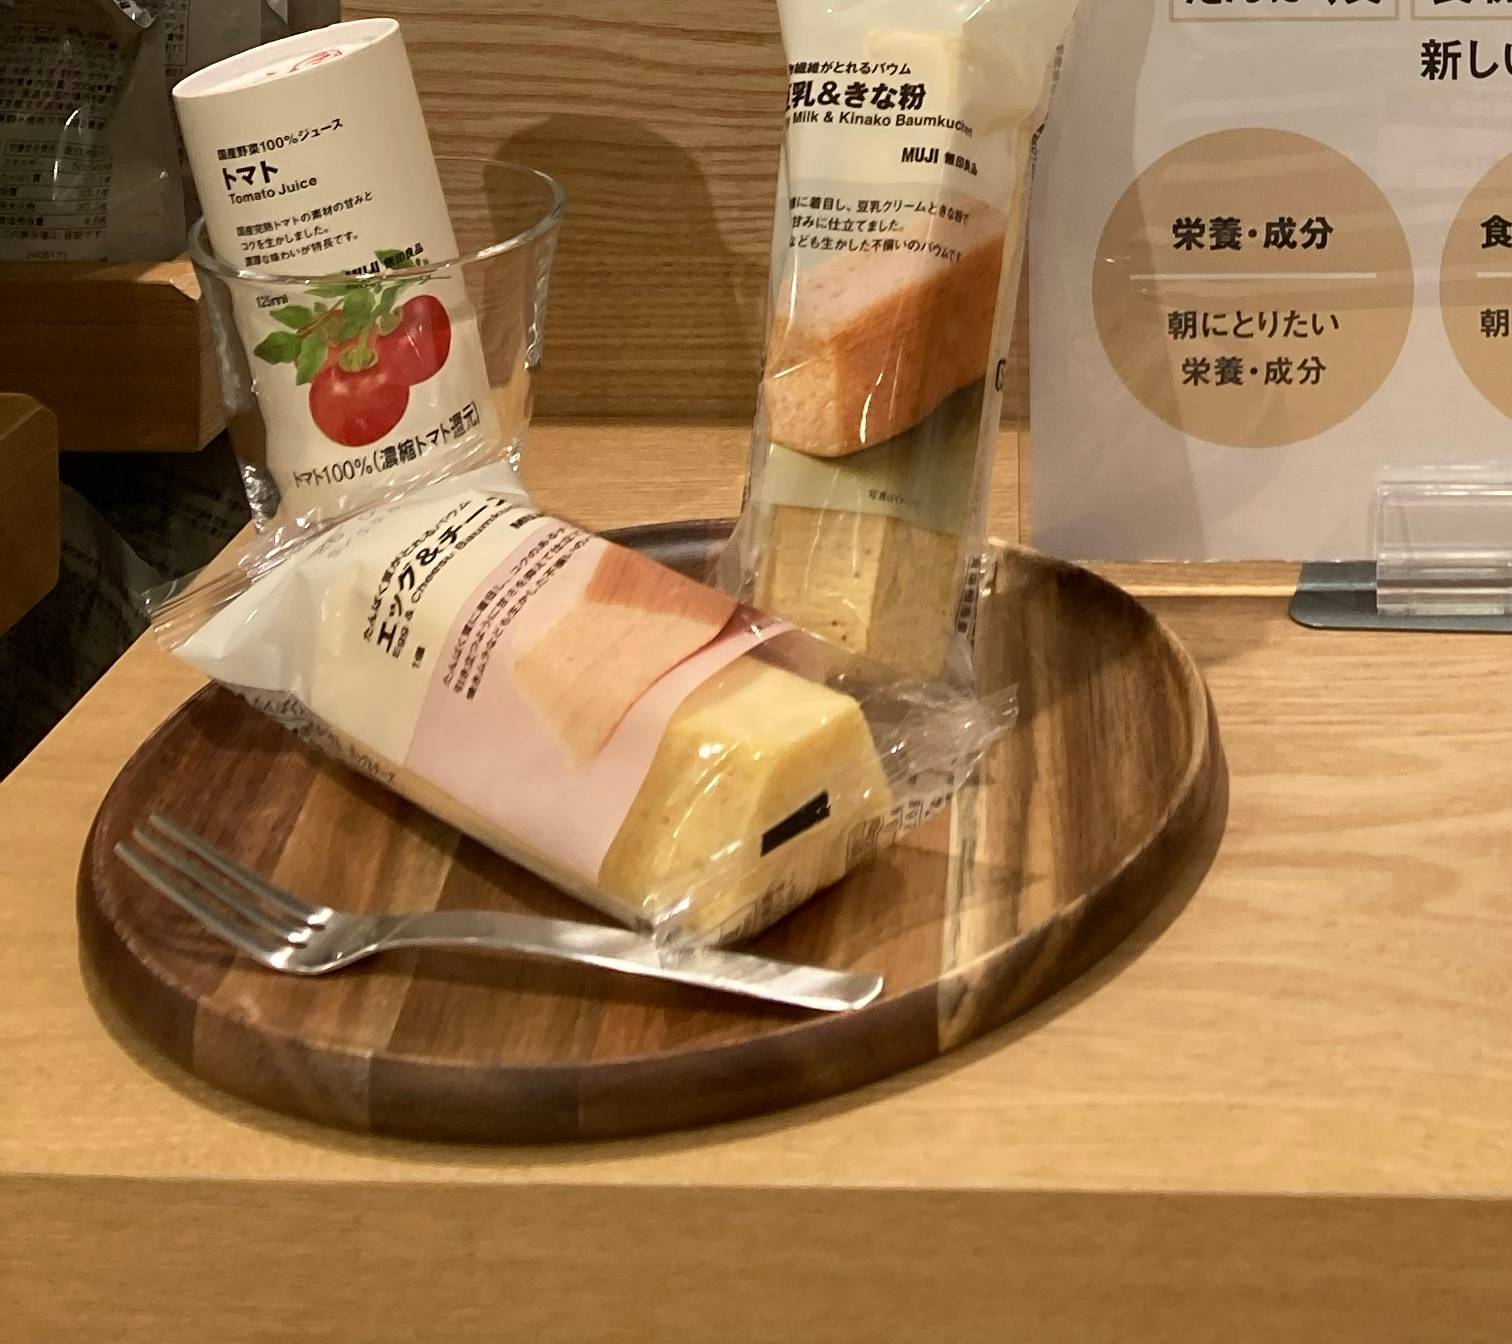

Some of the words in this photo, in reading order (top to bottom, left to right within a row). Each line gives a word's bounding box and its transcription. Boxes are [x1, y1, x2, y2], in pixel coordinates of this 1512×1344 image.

[786, 80, 926, 110] 乳&きな粉
[793, 111, 818, 124] Milk
[824, 112, 834, 123] &
[839, 112, 891, 126] Kinako
[217, 118, 343, 161] 国産野菜100%ジュース
[902, 147, 939, 163] MUJI
[222, 160, 279, 191] トマト
[228, 186, 276, 206] Tomato
[278, 175, 318, 196] Juice
[1170, 215, 1335, 252] 栄養・成分
[1166, 308, 1341, 341] 朝にとりたい
[1180, 353, 1327, 387] 栄養・成分
[292, 400, 481, 489] トマト100%(濃縮トマト還元)
[392, 626, 409, 658] Egg
[405, 610, 414, 621] &
